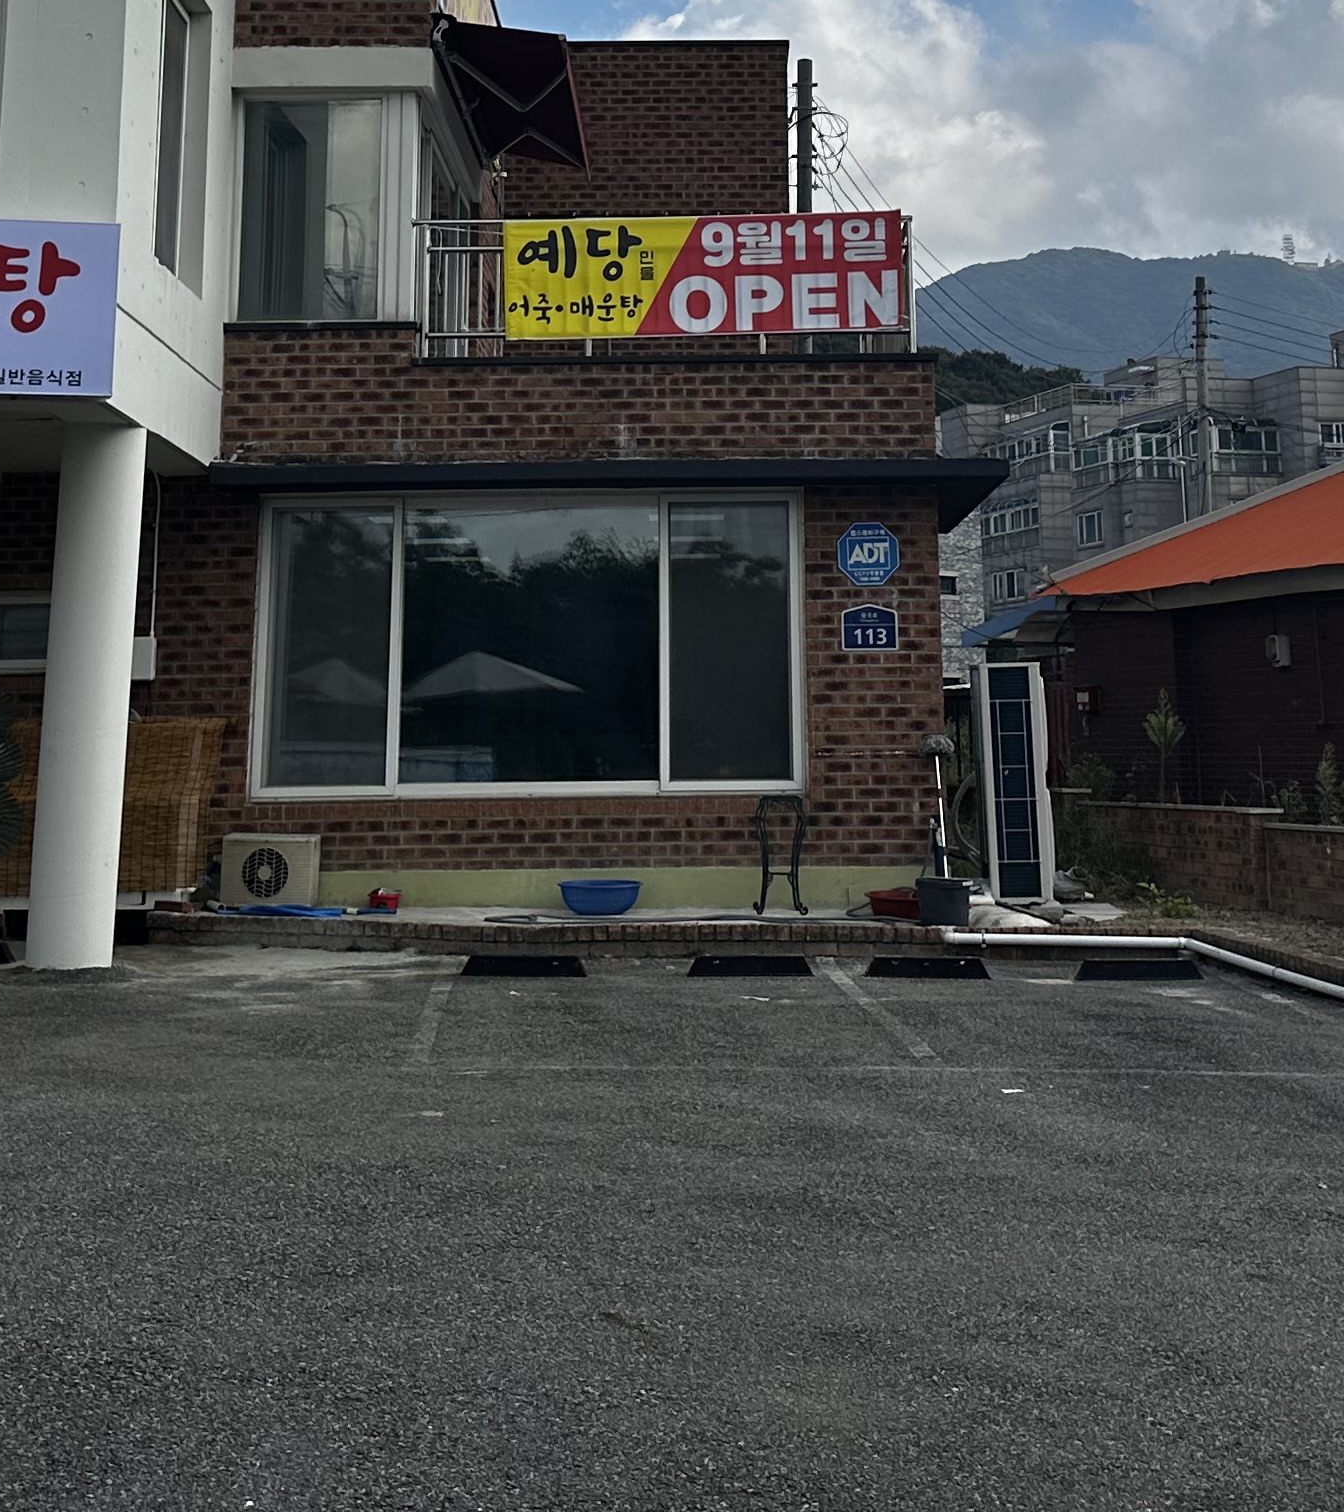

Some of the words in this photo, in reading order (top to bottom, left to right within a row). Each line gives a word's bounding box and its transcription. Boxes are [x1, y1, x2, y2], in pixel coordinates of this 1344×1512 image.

[517, 225, 643, 281] 예당
[700, 217, 887, 267] 9월11일
[669, 269, 899, 334] OPEN
[848, 541, 889, 565] ADT
[853, 628, 888, 646] 113
